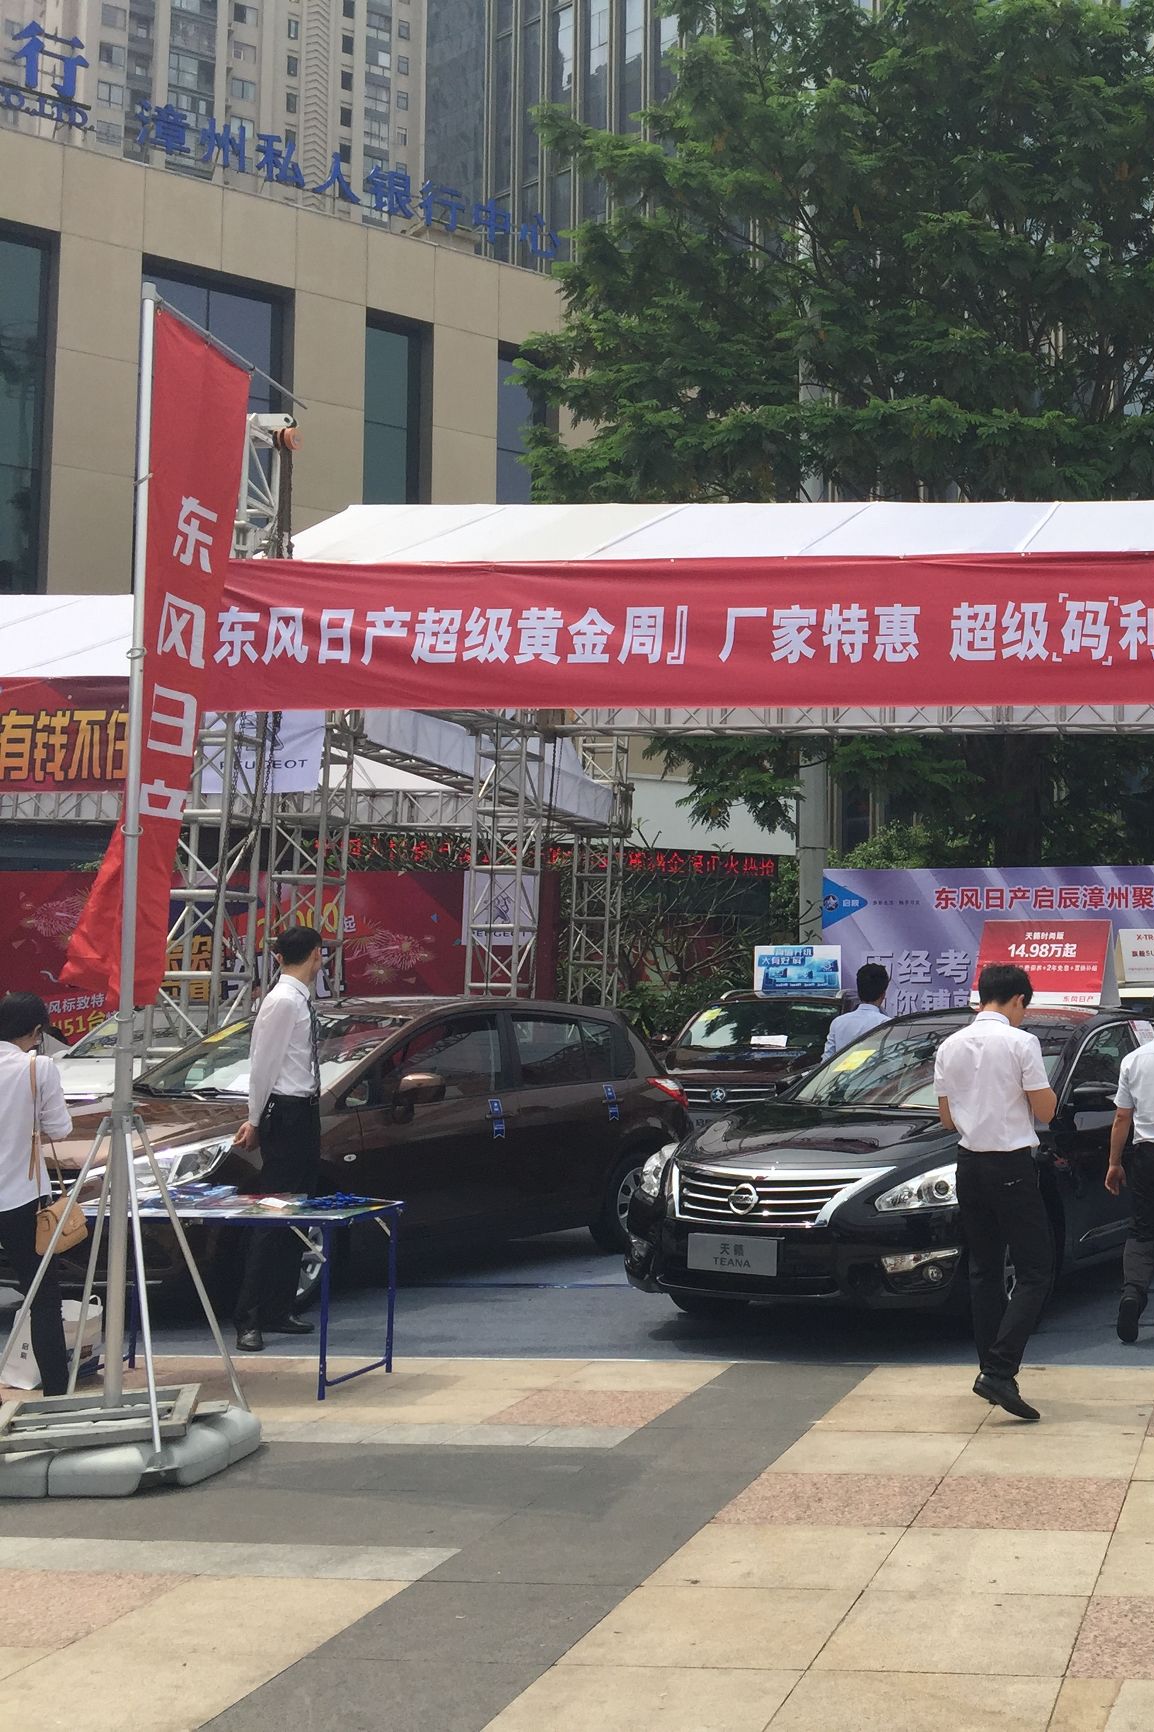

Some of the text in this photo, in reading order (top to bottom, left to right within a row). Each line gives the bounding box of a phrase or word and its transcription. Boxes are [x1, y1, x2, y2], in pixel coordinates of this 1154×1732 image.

[11, 20, 90, 99] 行
[136, 100, 562, 260] 漳州私人银行中心
[718, 603, 921, 664] 厂家特惠
[1008, 942, 1078, 958] 14.98万起
[44, 993, 105, 1014] 风标致特
[713, 1256, 752, 1268] TEANA
